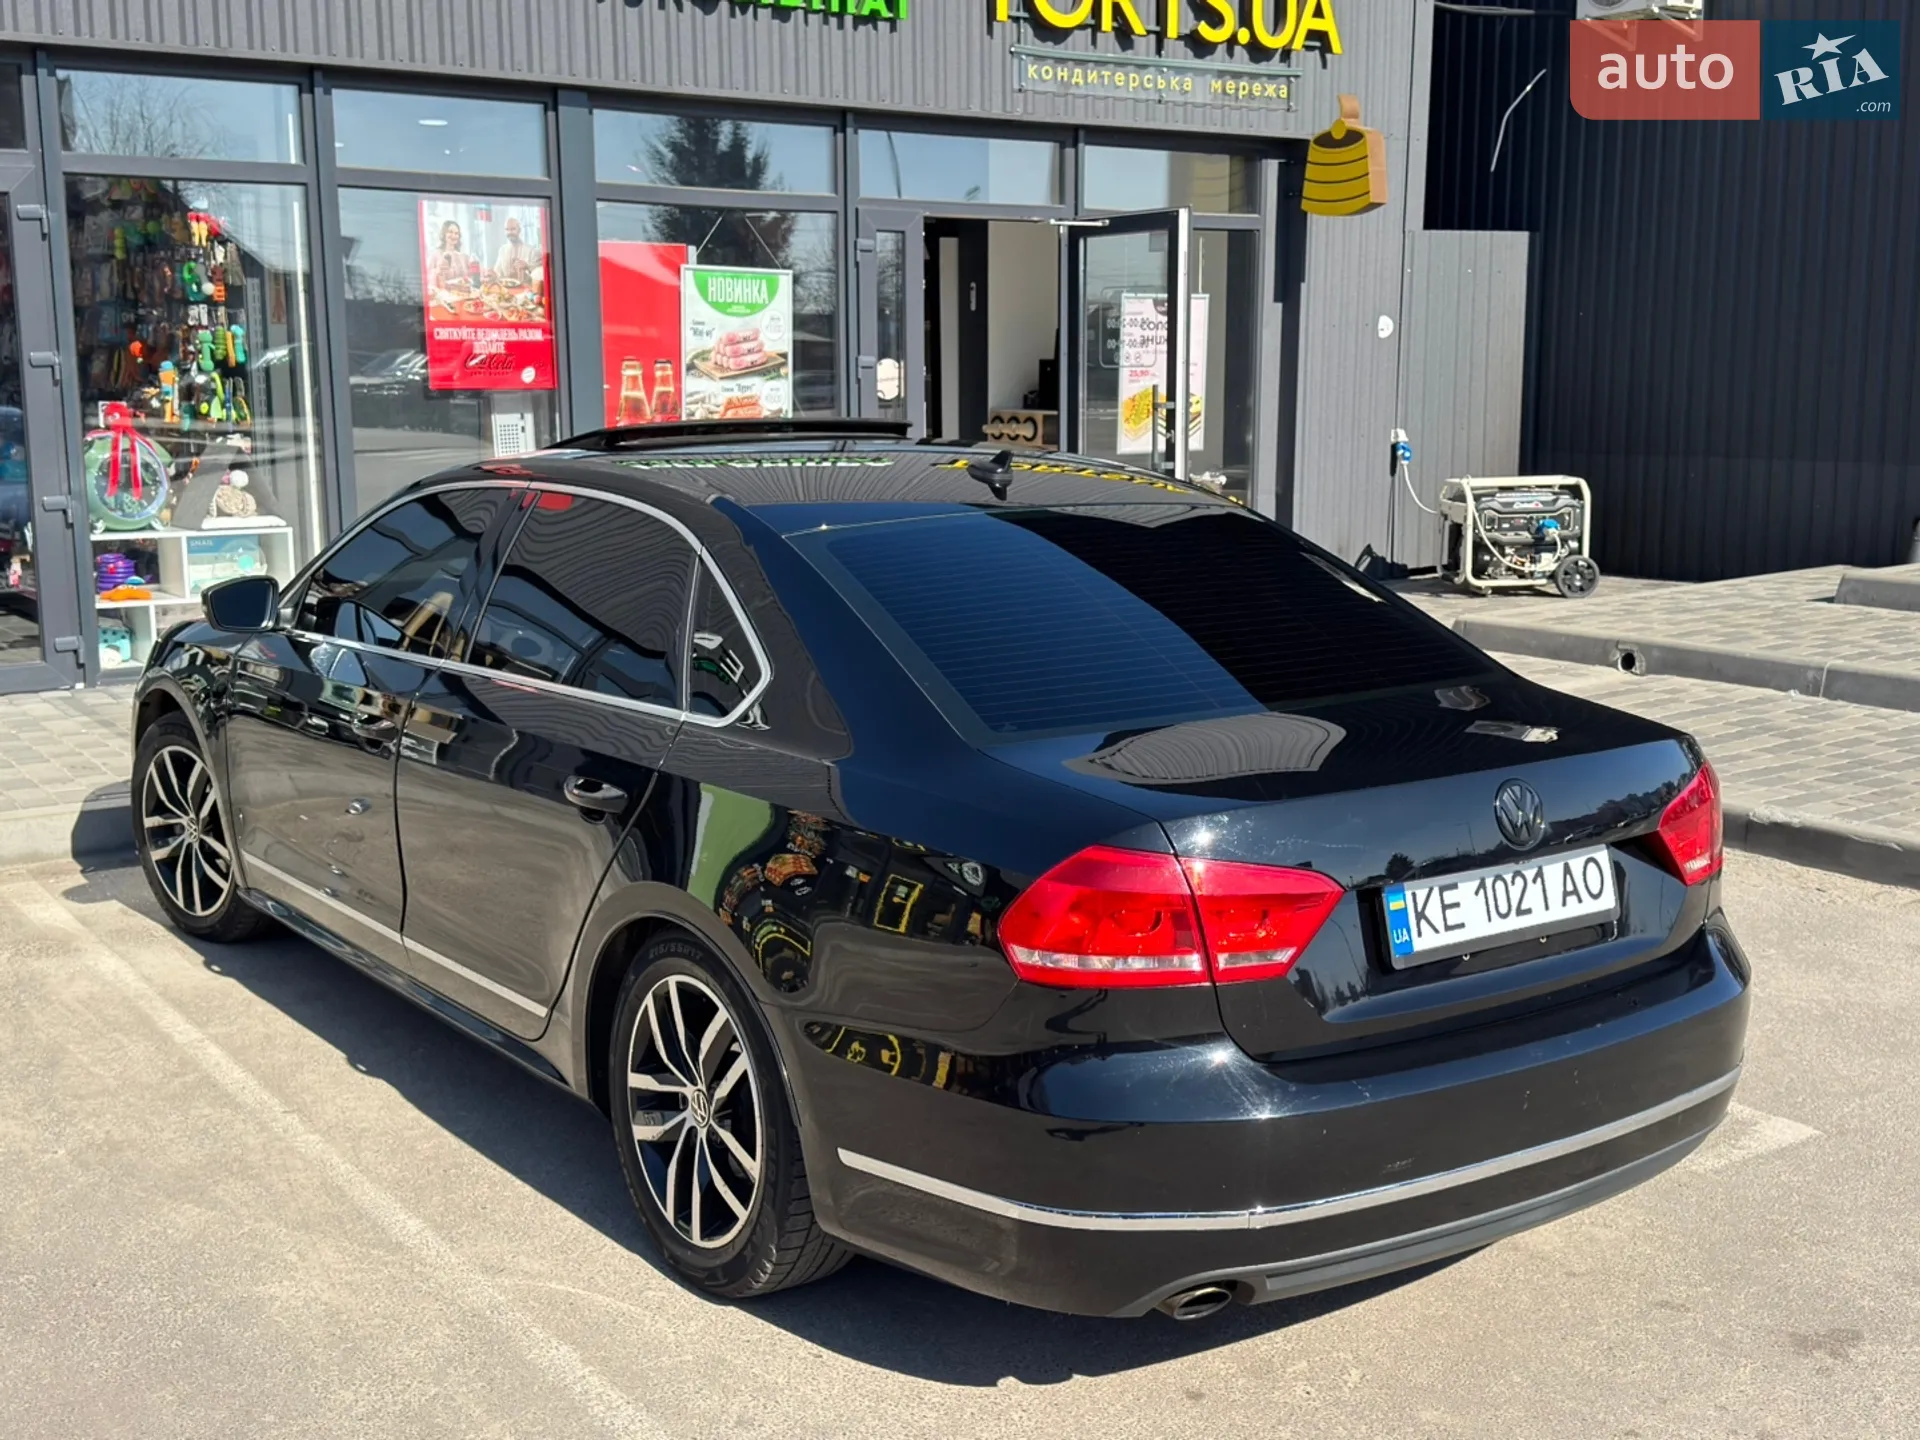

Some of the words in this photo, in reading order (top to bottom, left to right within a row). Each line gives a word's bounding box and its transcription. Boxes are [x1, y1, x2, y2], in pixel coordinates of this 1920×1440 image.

[1027, 64, 1193, 92] кондитерська
[1210, 81, 1289, 100] мережа
[707, 276, 769, 305] НОВИНКА
[1410, 882, 1466, 938] KE
[1474, 865, 1550, 923] 1021
[1561, 856, 1604, 907] AO
[1392, 929, 1410, 944] UA
